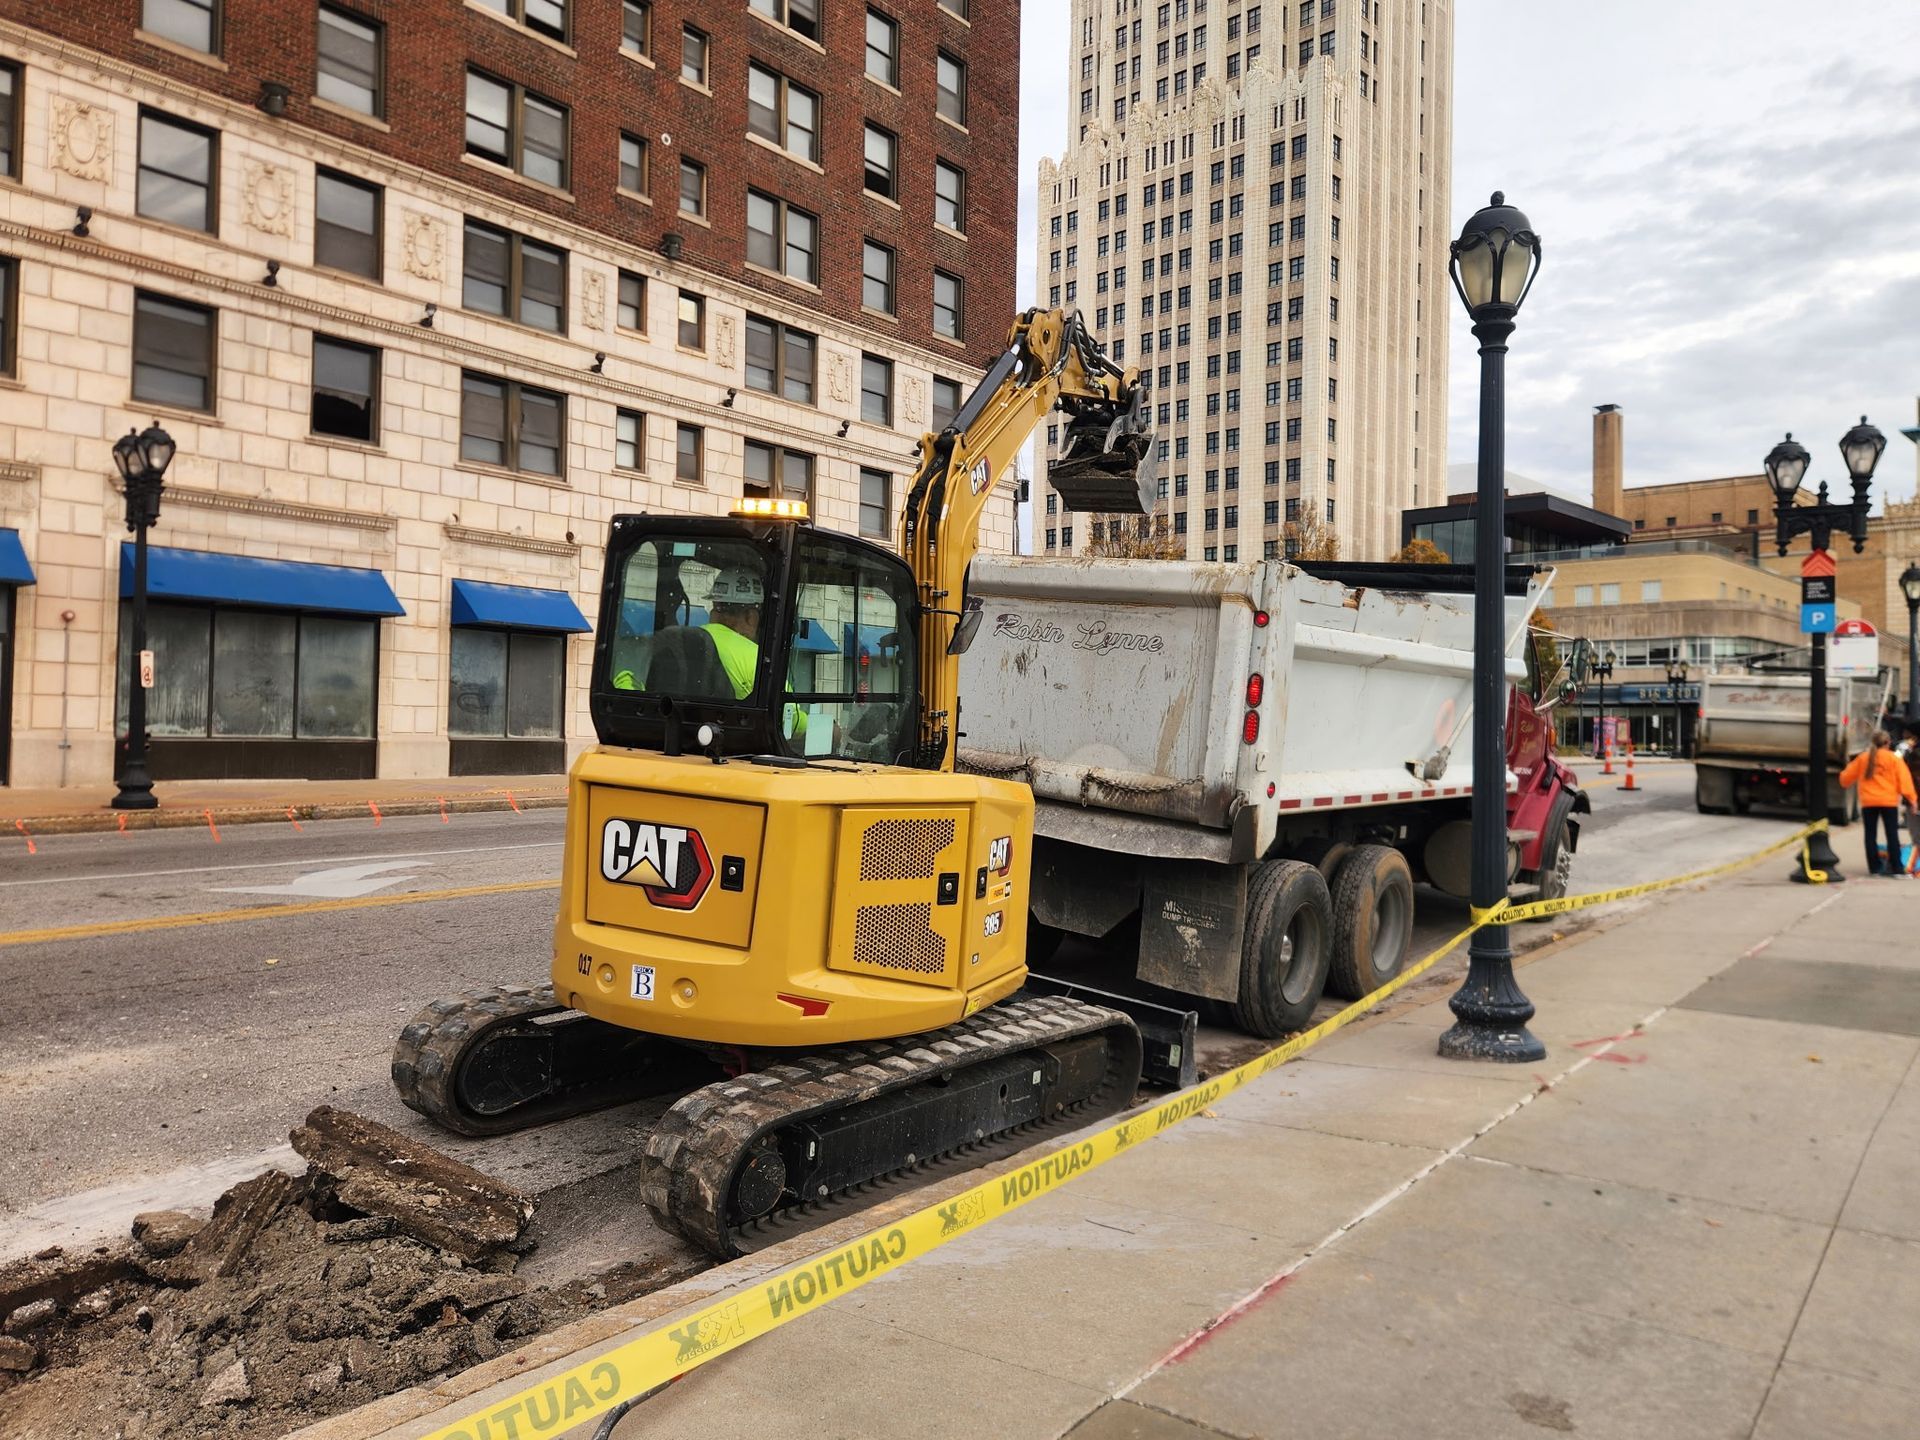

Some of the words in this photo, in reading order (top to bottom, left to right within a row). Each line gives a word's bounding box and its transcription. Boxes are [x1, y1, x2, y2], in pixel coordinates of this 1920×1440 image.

[970, 458, 987, 496] CAT
[1812, 612, 1825, 625] P
[993, 614, 1064, 644] Robin
[1071, 620, 1163, 656] Lynne
[603, 819, 687, 889] CAT
[989, 837, 1009, 871] CAT
[1162, 911, 1181, 922] DUMP
[578, 953, 592, 976] 017
[633, 973, 651, 995] B
